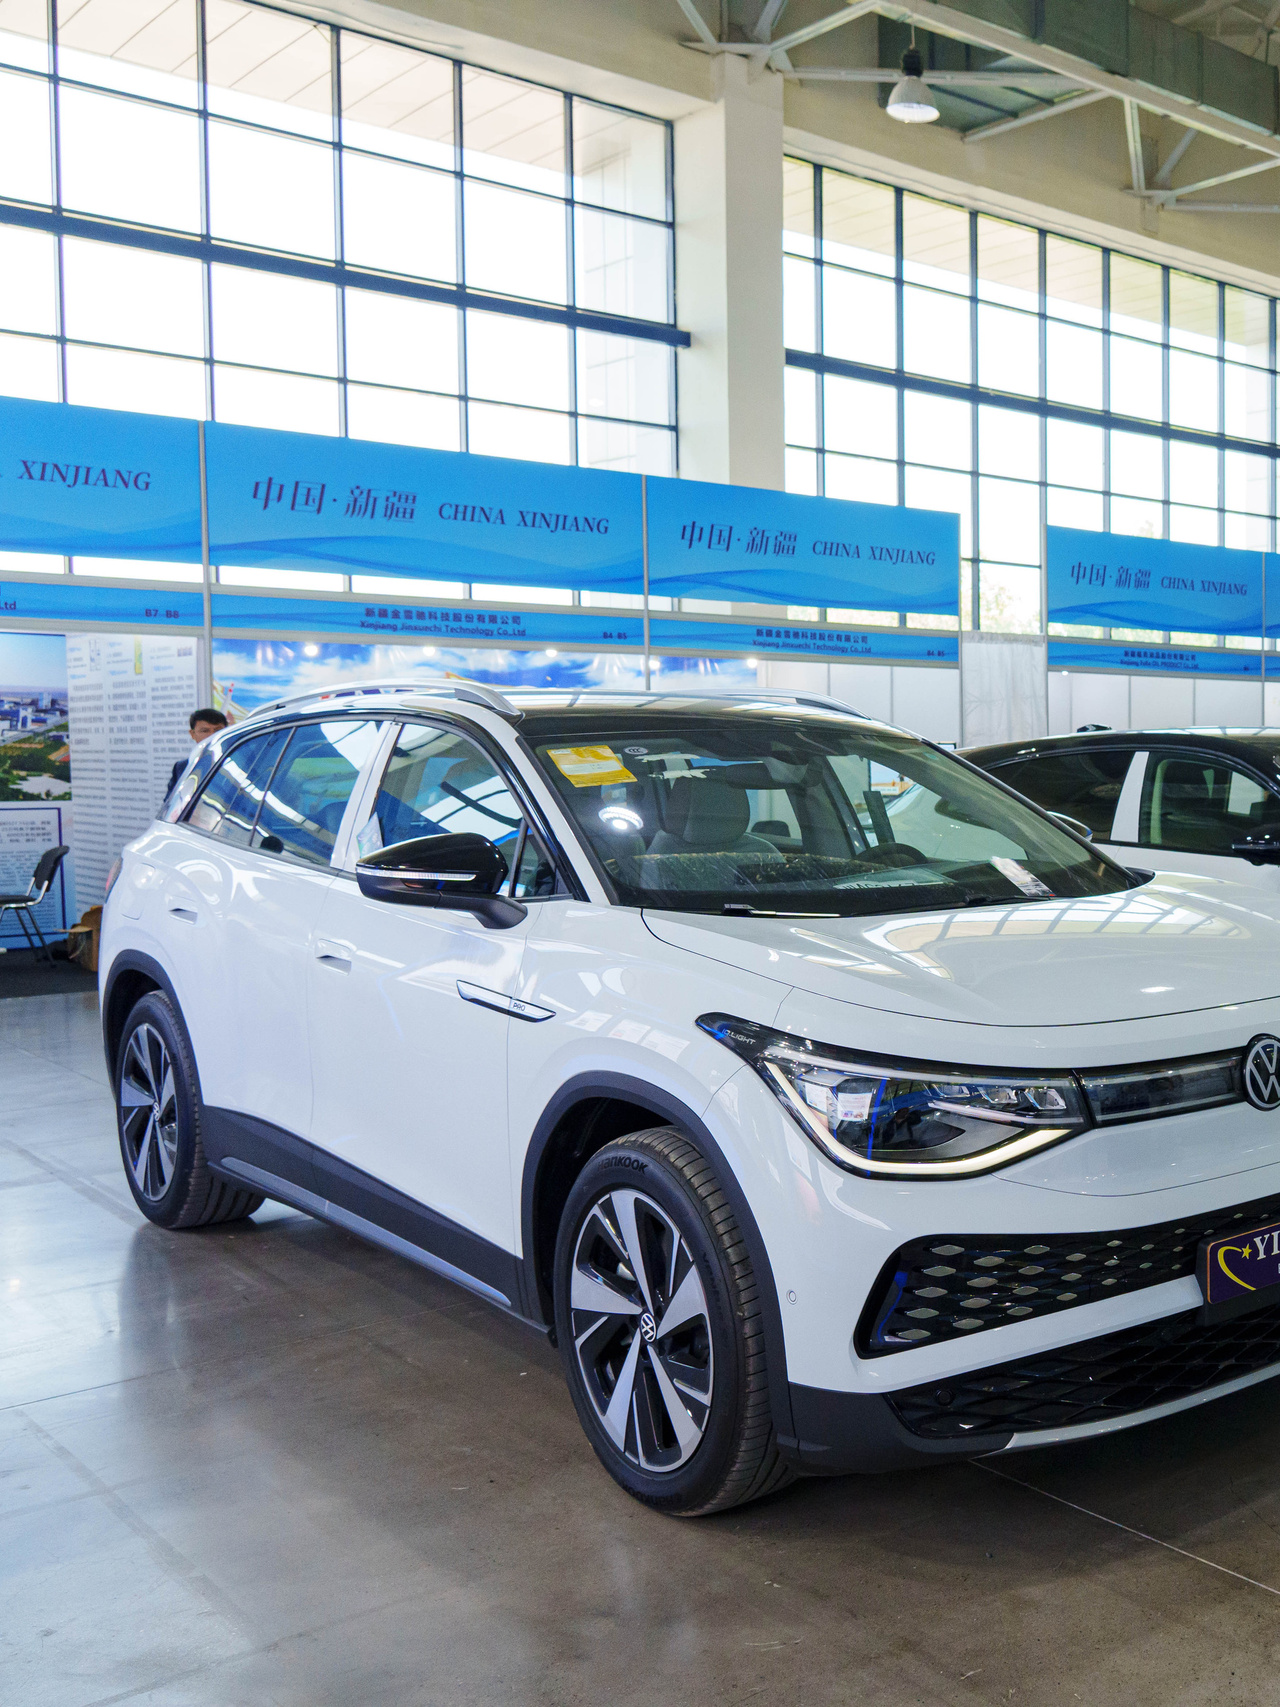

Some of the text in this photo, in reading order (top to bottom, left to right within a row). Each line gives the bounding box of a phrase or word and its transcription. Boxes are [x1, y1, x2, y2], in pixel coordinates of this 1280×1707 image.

[18, 459, 151, 491] XINJIANG
[253, 476, 418, 522] 中国·新疆
[438, 502, 609, 535] CHINA XINJIANG
[681, 520, 798, 558] 中国·新疆
[812, 540, 936, 566] CHINA XINJIANG
[1070, 561, 1151, 590] 中国·新疆
[1160, 575, 1248, 597] CHINA XINJIANG
[360, 620, 398, 632] Xinjiang
[445, 625, 494, 637] Technology
[513, 1002, 526, 1011] PRO
